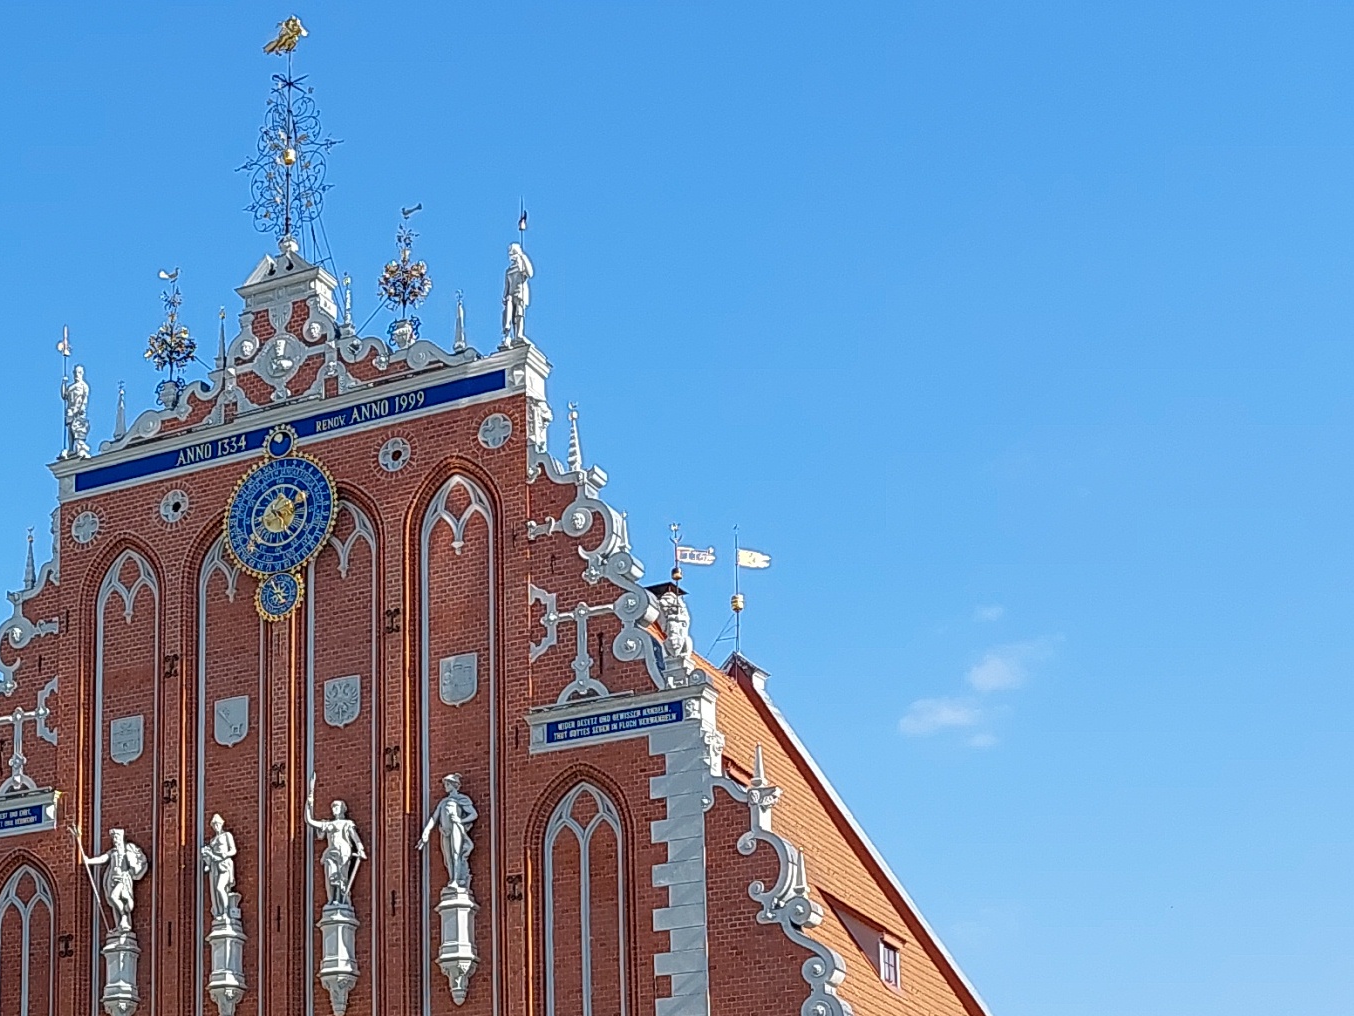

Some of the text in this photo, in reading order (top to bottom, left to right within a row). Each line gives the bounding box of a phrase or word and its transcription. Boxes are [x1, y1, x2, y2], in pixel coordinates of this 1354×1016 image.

[174, 443, 212, 466] ANNO
[217, 434, 247, 456] 1334
[349, 400, 389, 424] ANNO
[394, 391, 425, 413] 1999
